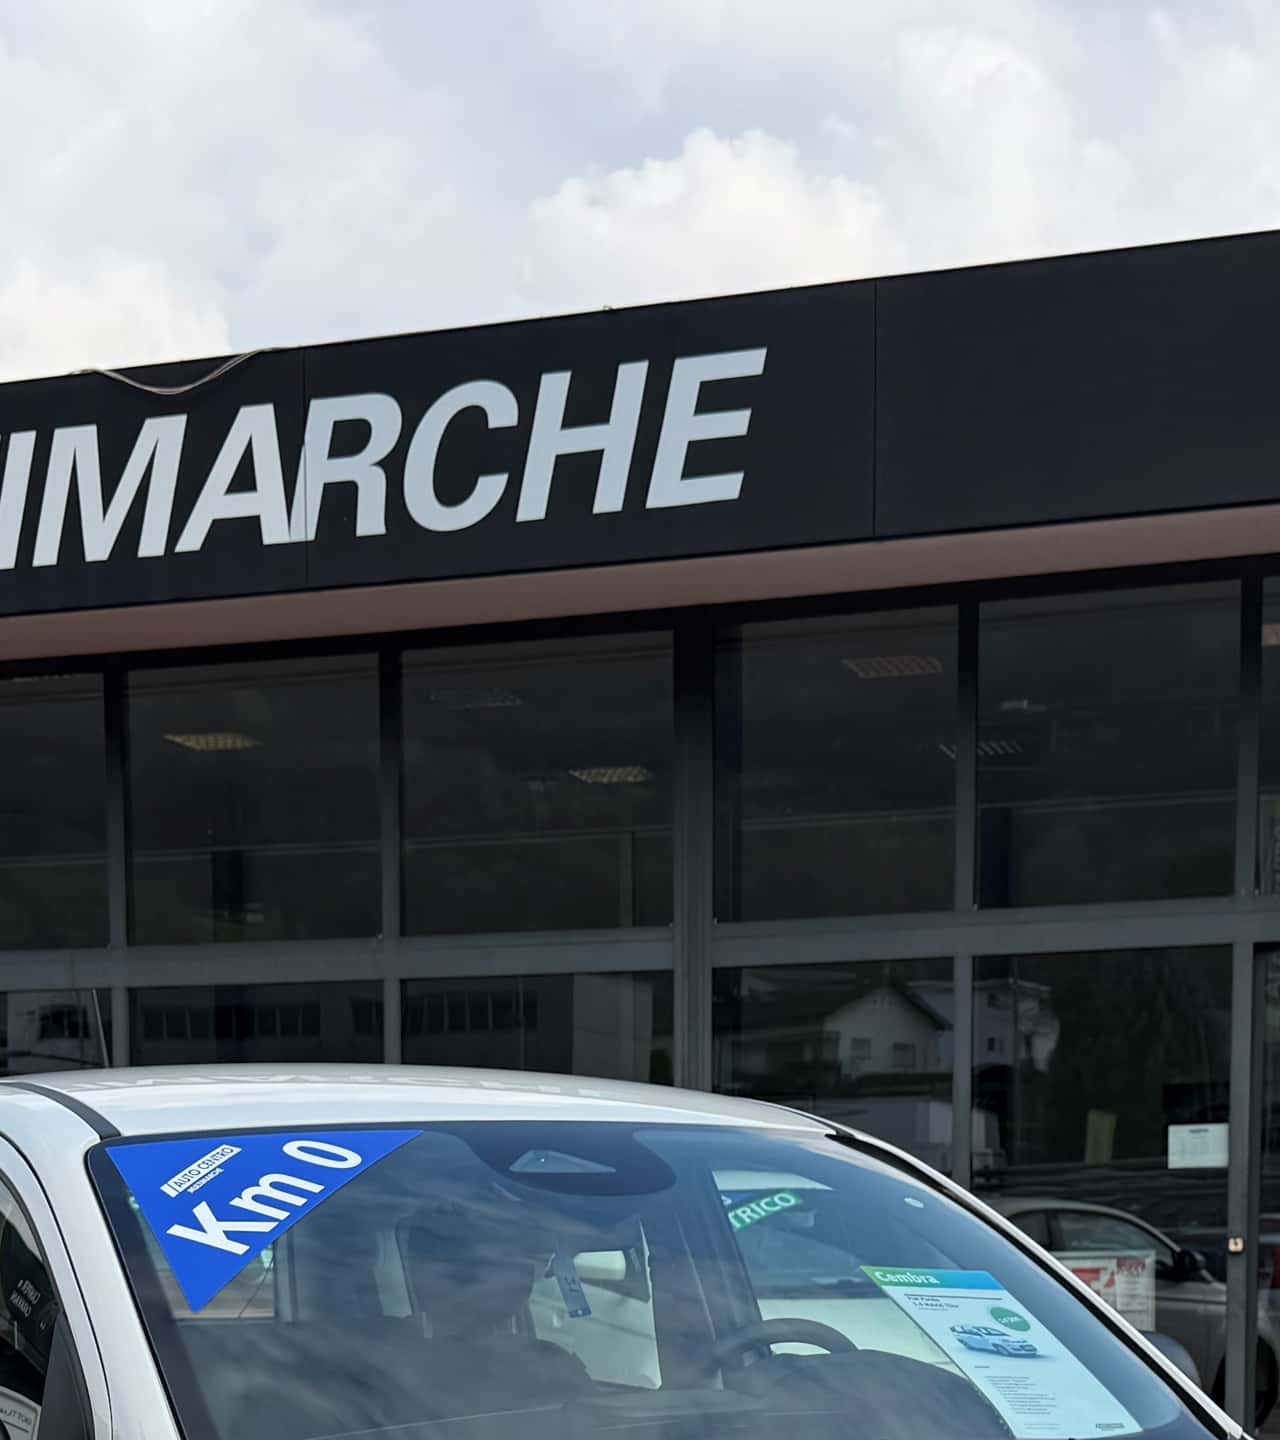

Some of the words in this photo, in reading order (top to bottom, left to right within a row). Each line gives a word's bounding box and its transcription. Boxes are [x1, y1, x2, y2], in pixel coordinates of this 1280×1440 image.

[174, 1169, 201, 1188] AUTO
[197, 1146, 234, 1170] CENTRO
[166, 1173, 325, 1255] Km
[282, 1140, 363, 1169] 0
[874, 1271, 941, 1285] Cembra
